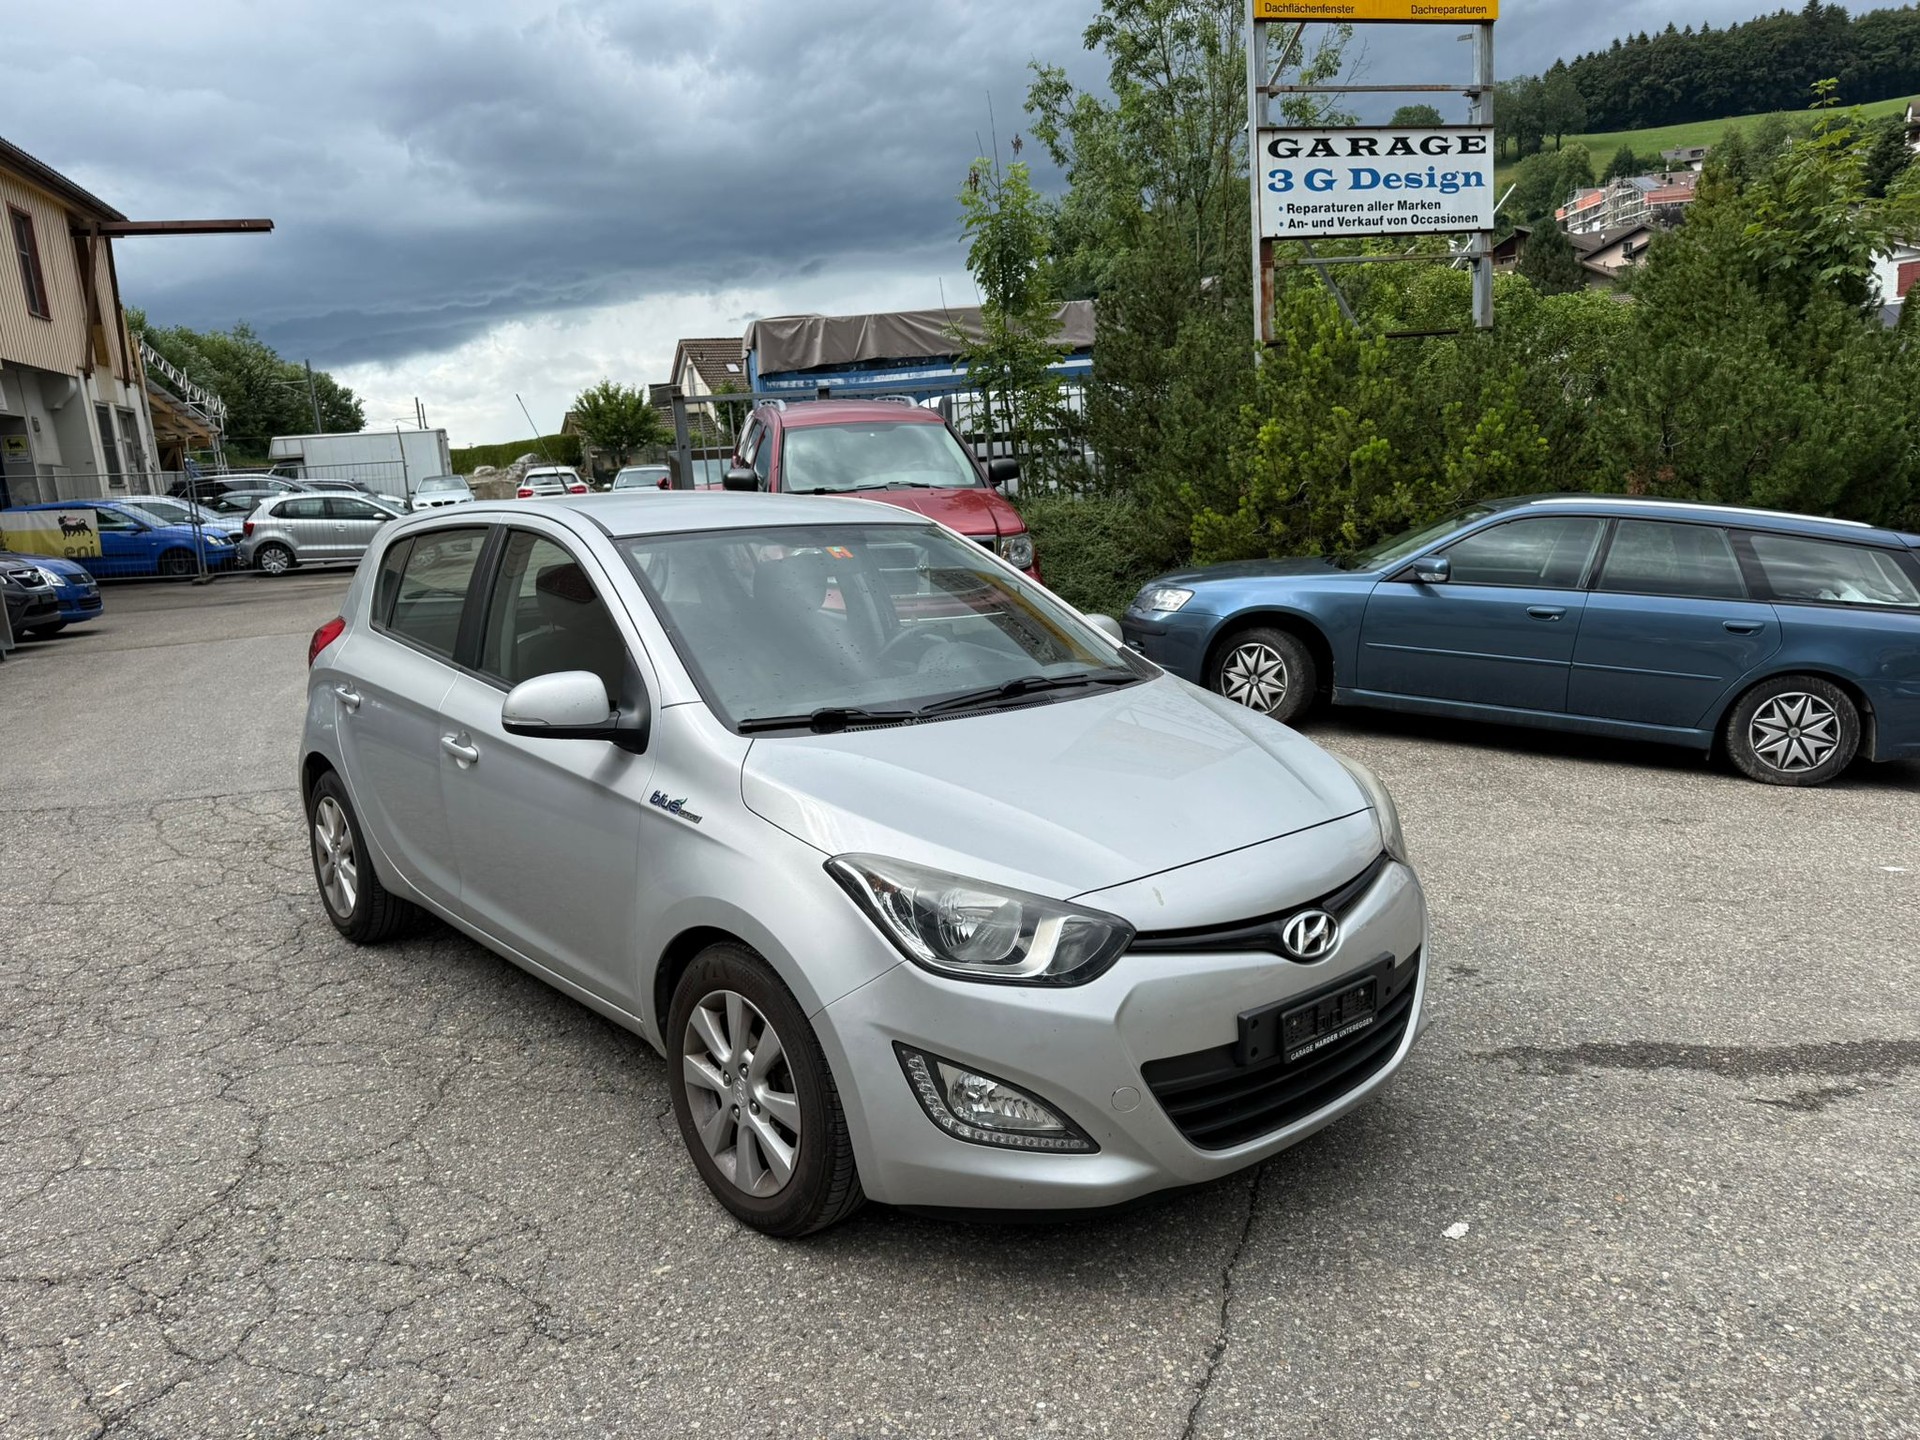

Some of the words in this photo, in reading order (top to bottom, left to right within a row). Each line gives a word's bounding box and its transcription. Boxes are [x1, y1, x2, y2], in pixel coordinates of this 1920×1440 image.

[1264, 2, 1355, 14] Dachflächenfenster
[1410, 4, 1487, 15] Dachreparaturen
[1267, 135, 1487, 159] GARAGE
[1267, 169, 1294, 192] 3
[1303, 168, 1338, 192] G
[1347, 166, 1486, 194] Design
[1286, 203, 1364, 215] Reparaturen
[1367, 201, 1394, 212] aller
[1397, 200, 1441, 211] Marken
[1288, 219, 1309, 229] An-
[1311, 217, 1334, 228] und
[1338, 215, 1384, 227] Verkauf
[1387, 216, 1407, 226] von
[1410, 214, 1479, 225] Occasionen
[63, 541, 96, 558] eni
[1290, 1045, 1314, 1061] GARAGE
